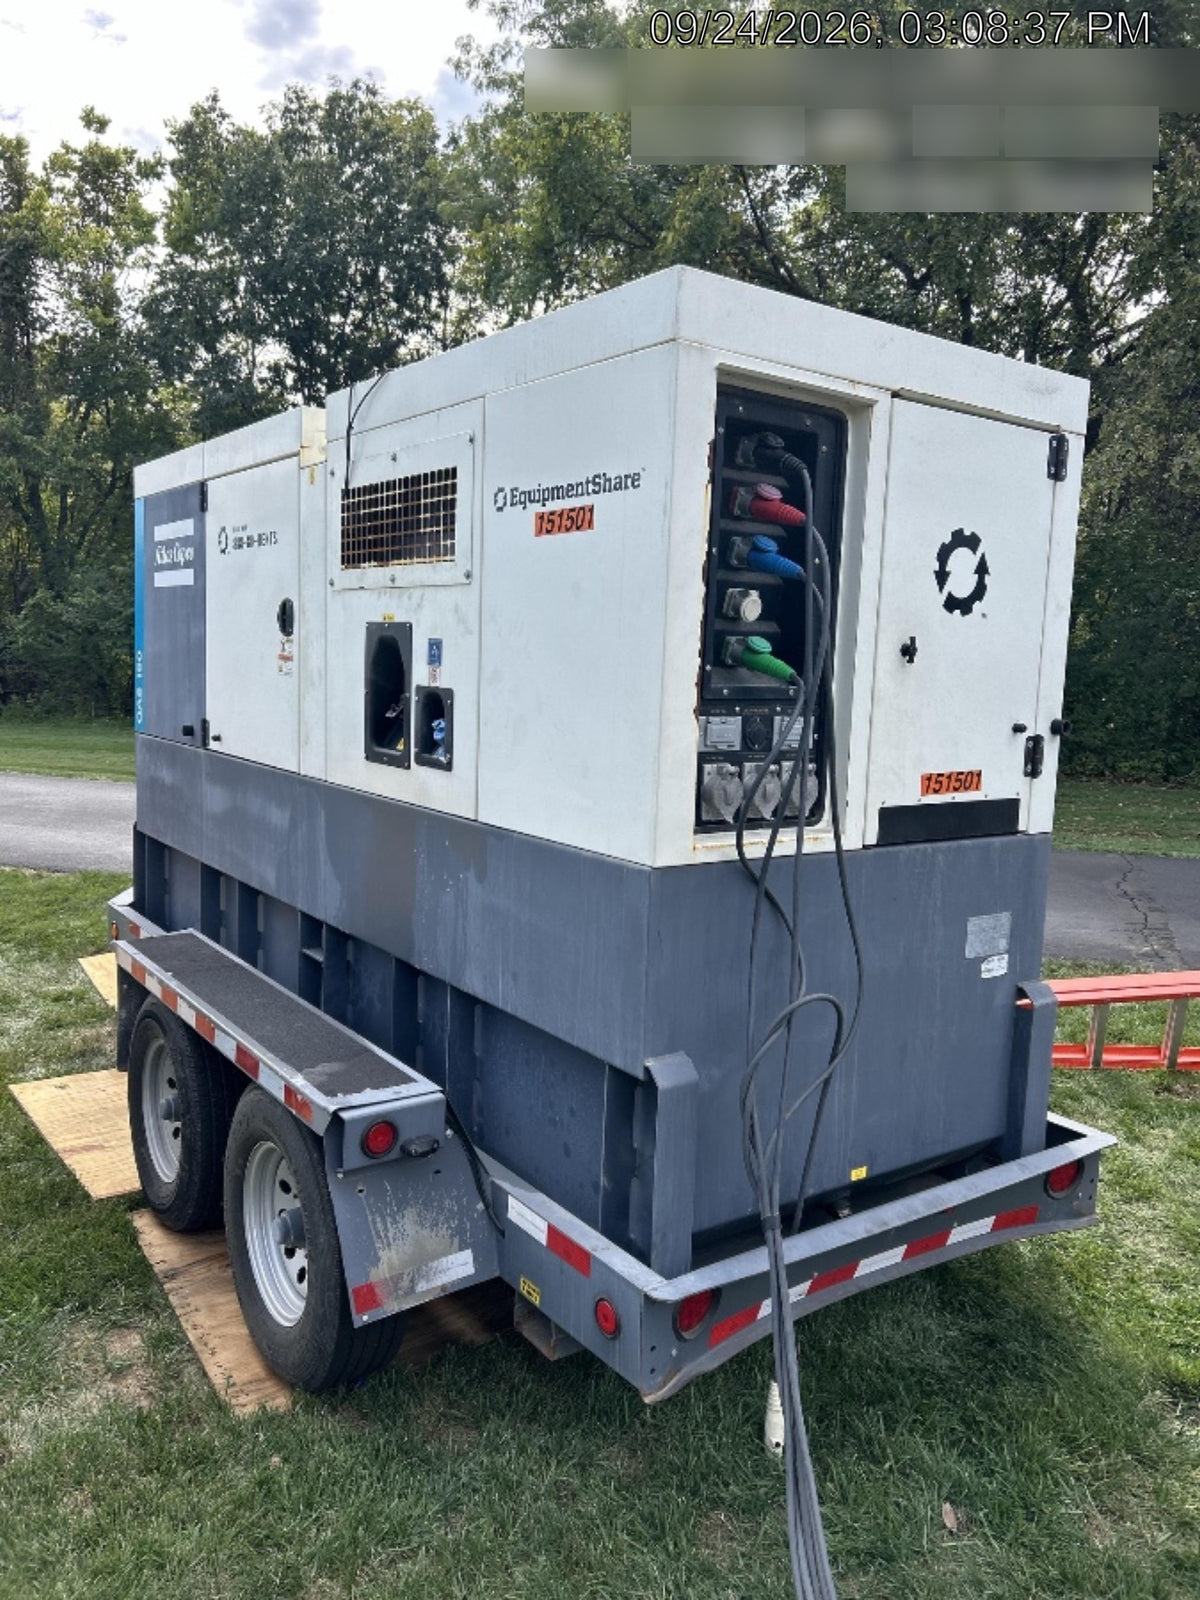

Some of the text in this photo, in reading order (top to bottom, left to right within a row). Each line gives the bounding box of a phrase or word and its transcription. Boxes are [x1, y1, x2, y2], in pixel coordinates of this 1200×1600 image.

[509, 471, 641, 510] EquipmentShare
[537, 504, 595, 535] 151501
[924, 769, 982, 795] 151501
